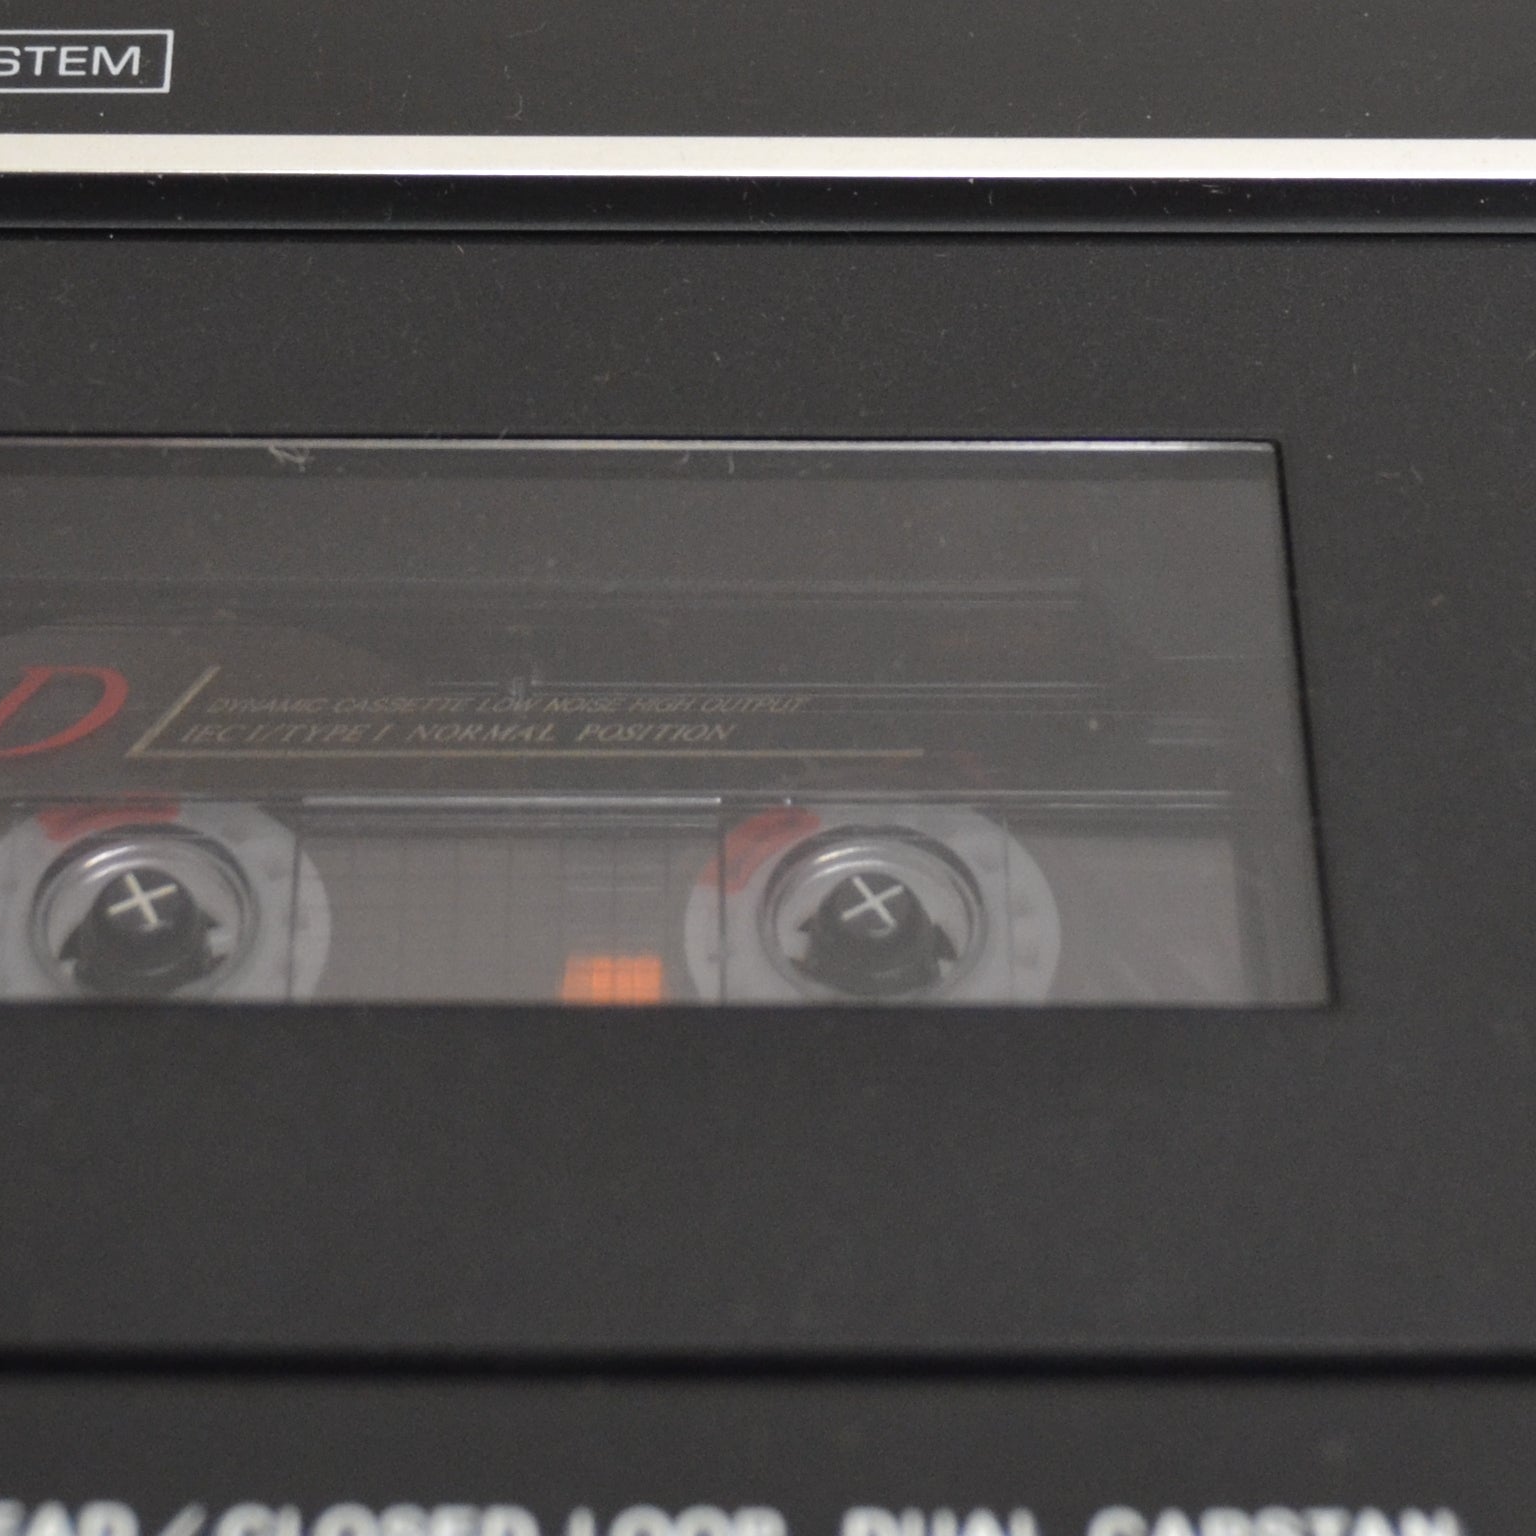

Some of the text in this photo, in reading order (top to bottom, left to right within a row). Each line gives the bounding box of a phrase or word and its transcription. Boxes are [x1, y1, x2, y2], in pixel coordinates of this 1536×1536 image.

[207, 696, 810, 714] DYNAMIC CASSETTE LOW NOISE HIGH OUTPUT
[406, 723, 559, 743] NORMAL
[577, 723, 738, 743] POSITION
